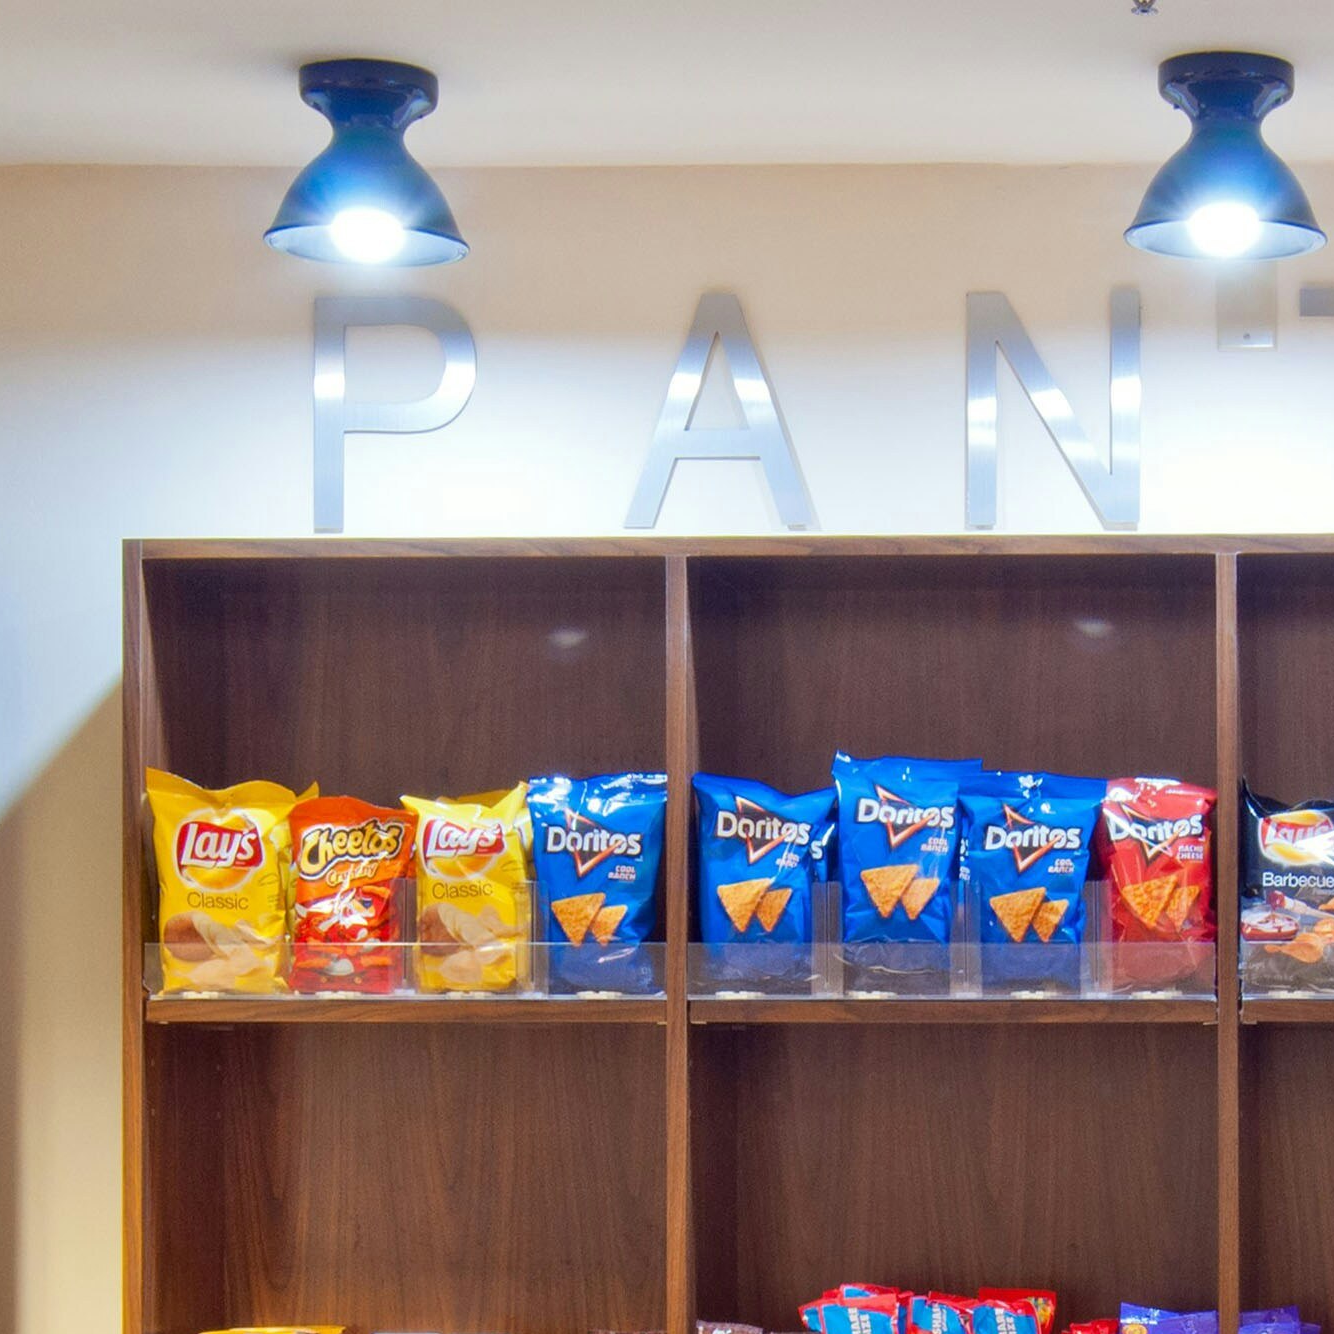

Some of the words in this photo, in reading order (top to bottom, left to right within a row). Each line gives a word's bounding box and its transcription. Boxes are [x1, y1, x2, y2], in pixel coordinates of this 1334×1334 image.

[858, 798, 955, 828] Doritos
[1108, 813, 1203, 842] Doritos
[426, 820, 500, 857] Lay's
[547, 826, 642, 854] Doritos
[717, 811, 811, 845] Doritos
[985, 825, 1081, 850] Doritos
[181, 822, 257, 867] Lay's
[299, 818, 402, 876] Cheetos
[431, 880, 494, 900] Classic
[1262, 871, 1334, 889] Barbecue
[186, 891, 249, 911] Classic
